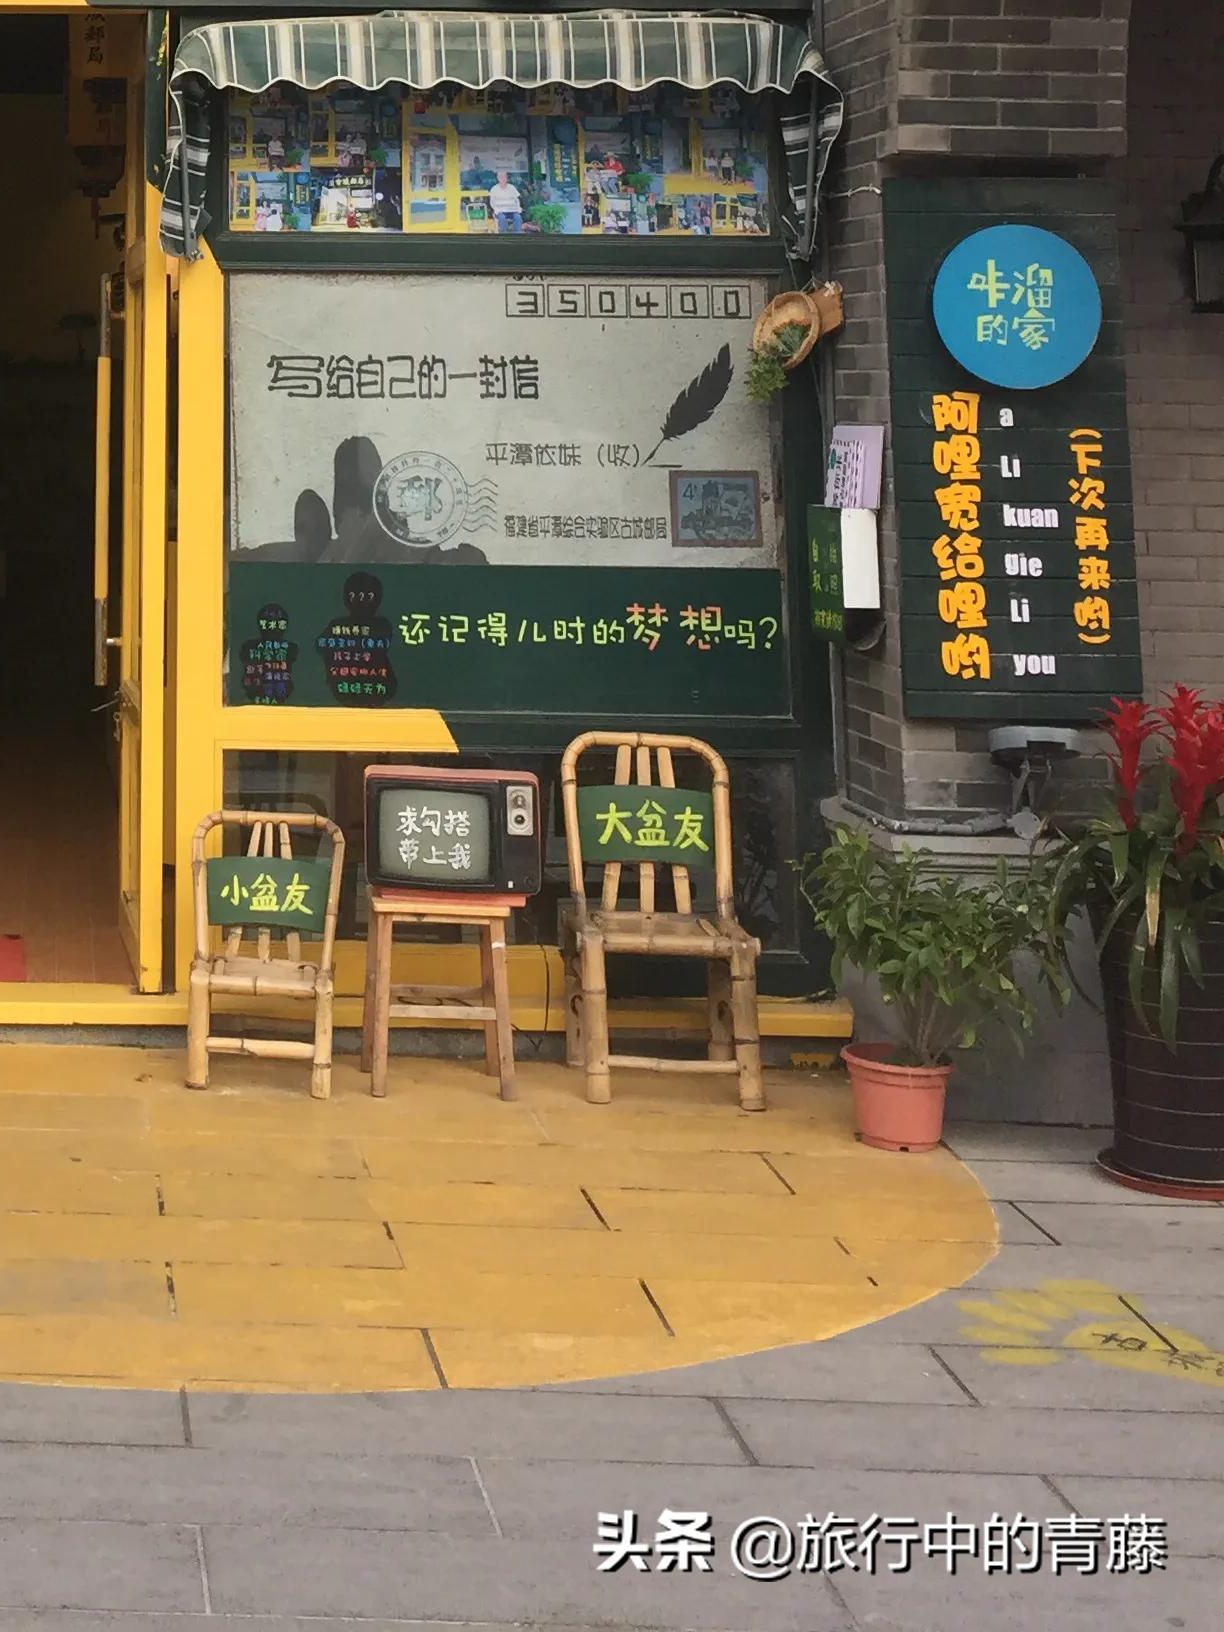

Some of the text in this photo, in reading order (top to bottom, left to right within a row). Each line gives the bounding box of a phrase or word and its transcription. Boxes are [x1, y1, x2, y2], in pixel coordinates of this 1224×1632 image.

[517, 289, 742, 317] 350400
[976, 308, 1056, 350] 的家
[266, 354, 540, 399] 写给自己的一封信
[999, 408, 1014, 427] a
[1002, 504, 1059, 528] kuan
[1004, 552, 1043, 577] gie
[1013, 654, 1056, 677] you
[397, 805, 471, 838] 求勾搭
[596, 799, 710, 851] 大盆友
[398, 838, 472, 870] 带上我
[221, 873, 313, 916] 小盆友
